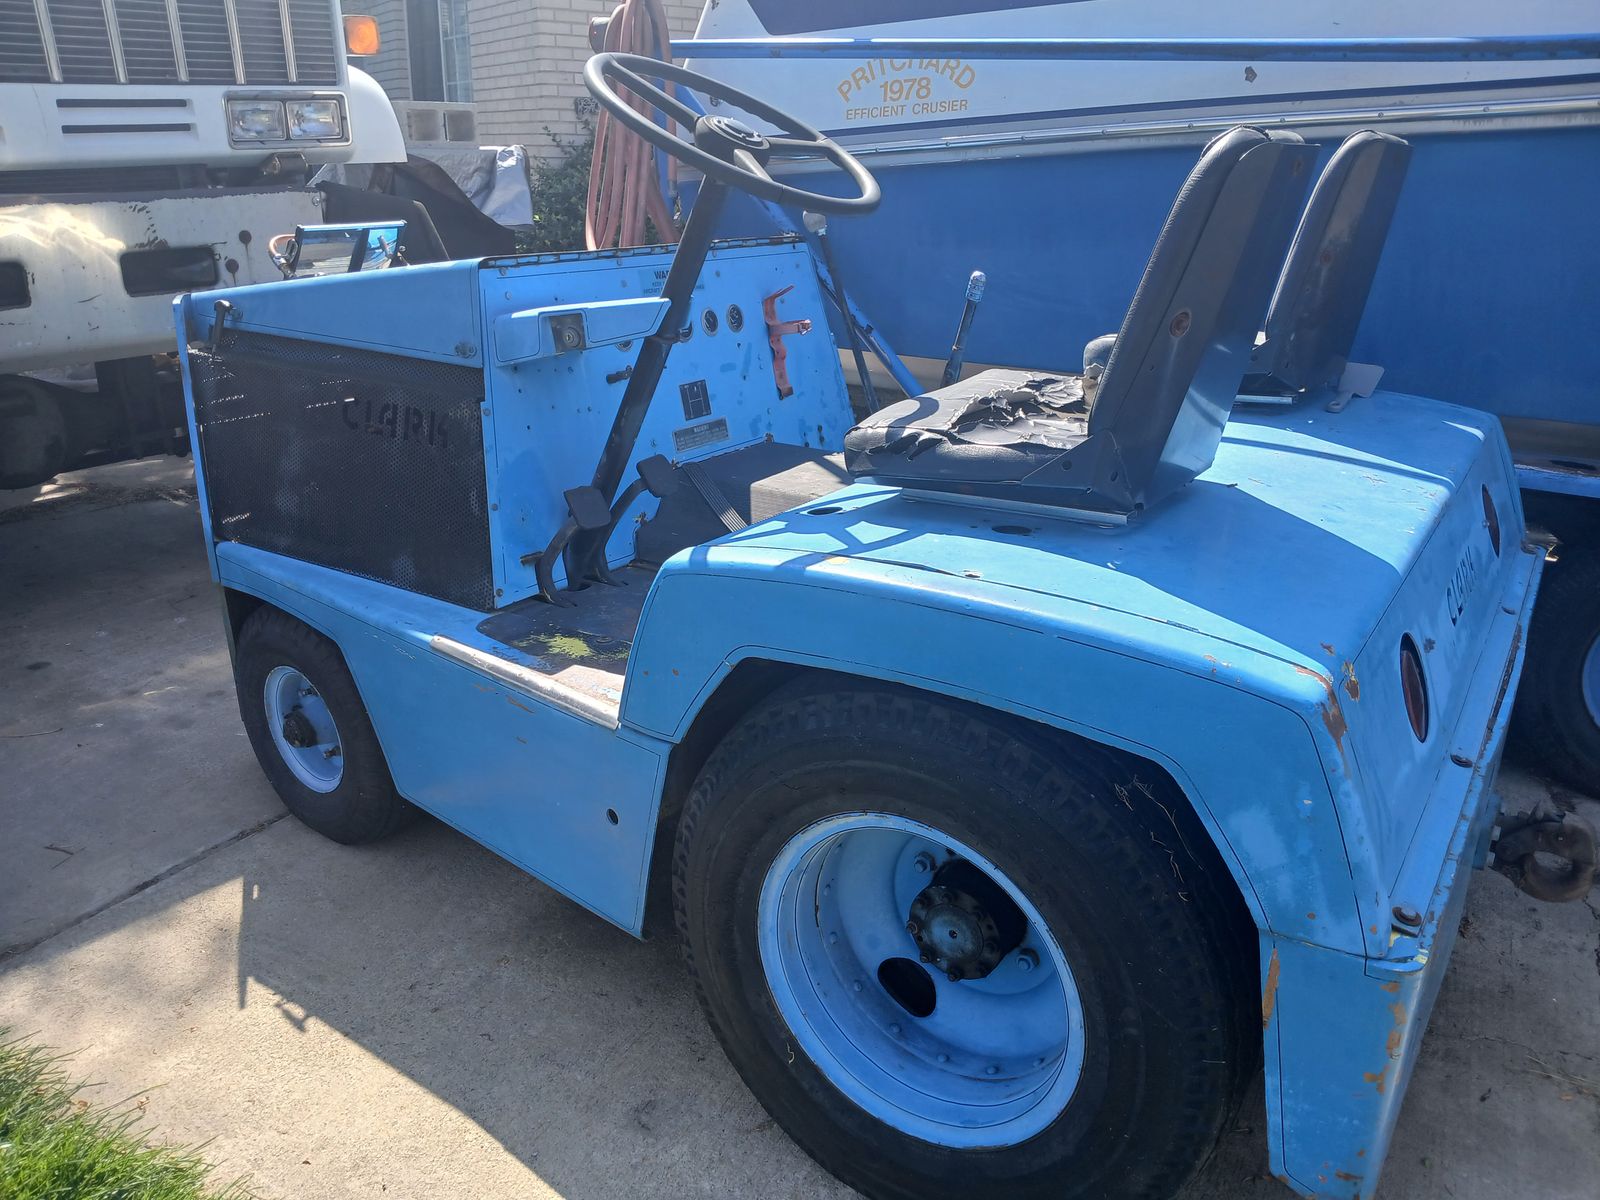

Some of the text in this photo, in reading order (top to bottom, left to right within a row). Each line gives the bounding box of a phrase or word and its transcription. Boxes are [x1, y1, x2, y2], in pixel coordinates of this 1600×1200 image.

[880, 77, 931, 102] 1978
[846, 104, 906, 120] EFFICIENT
[912, 99, 968, 115] CRUSIER
